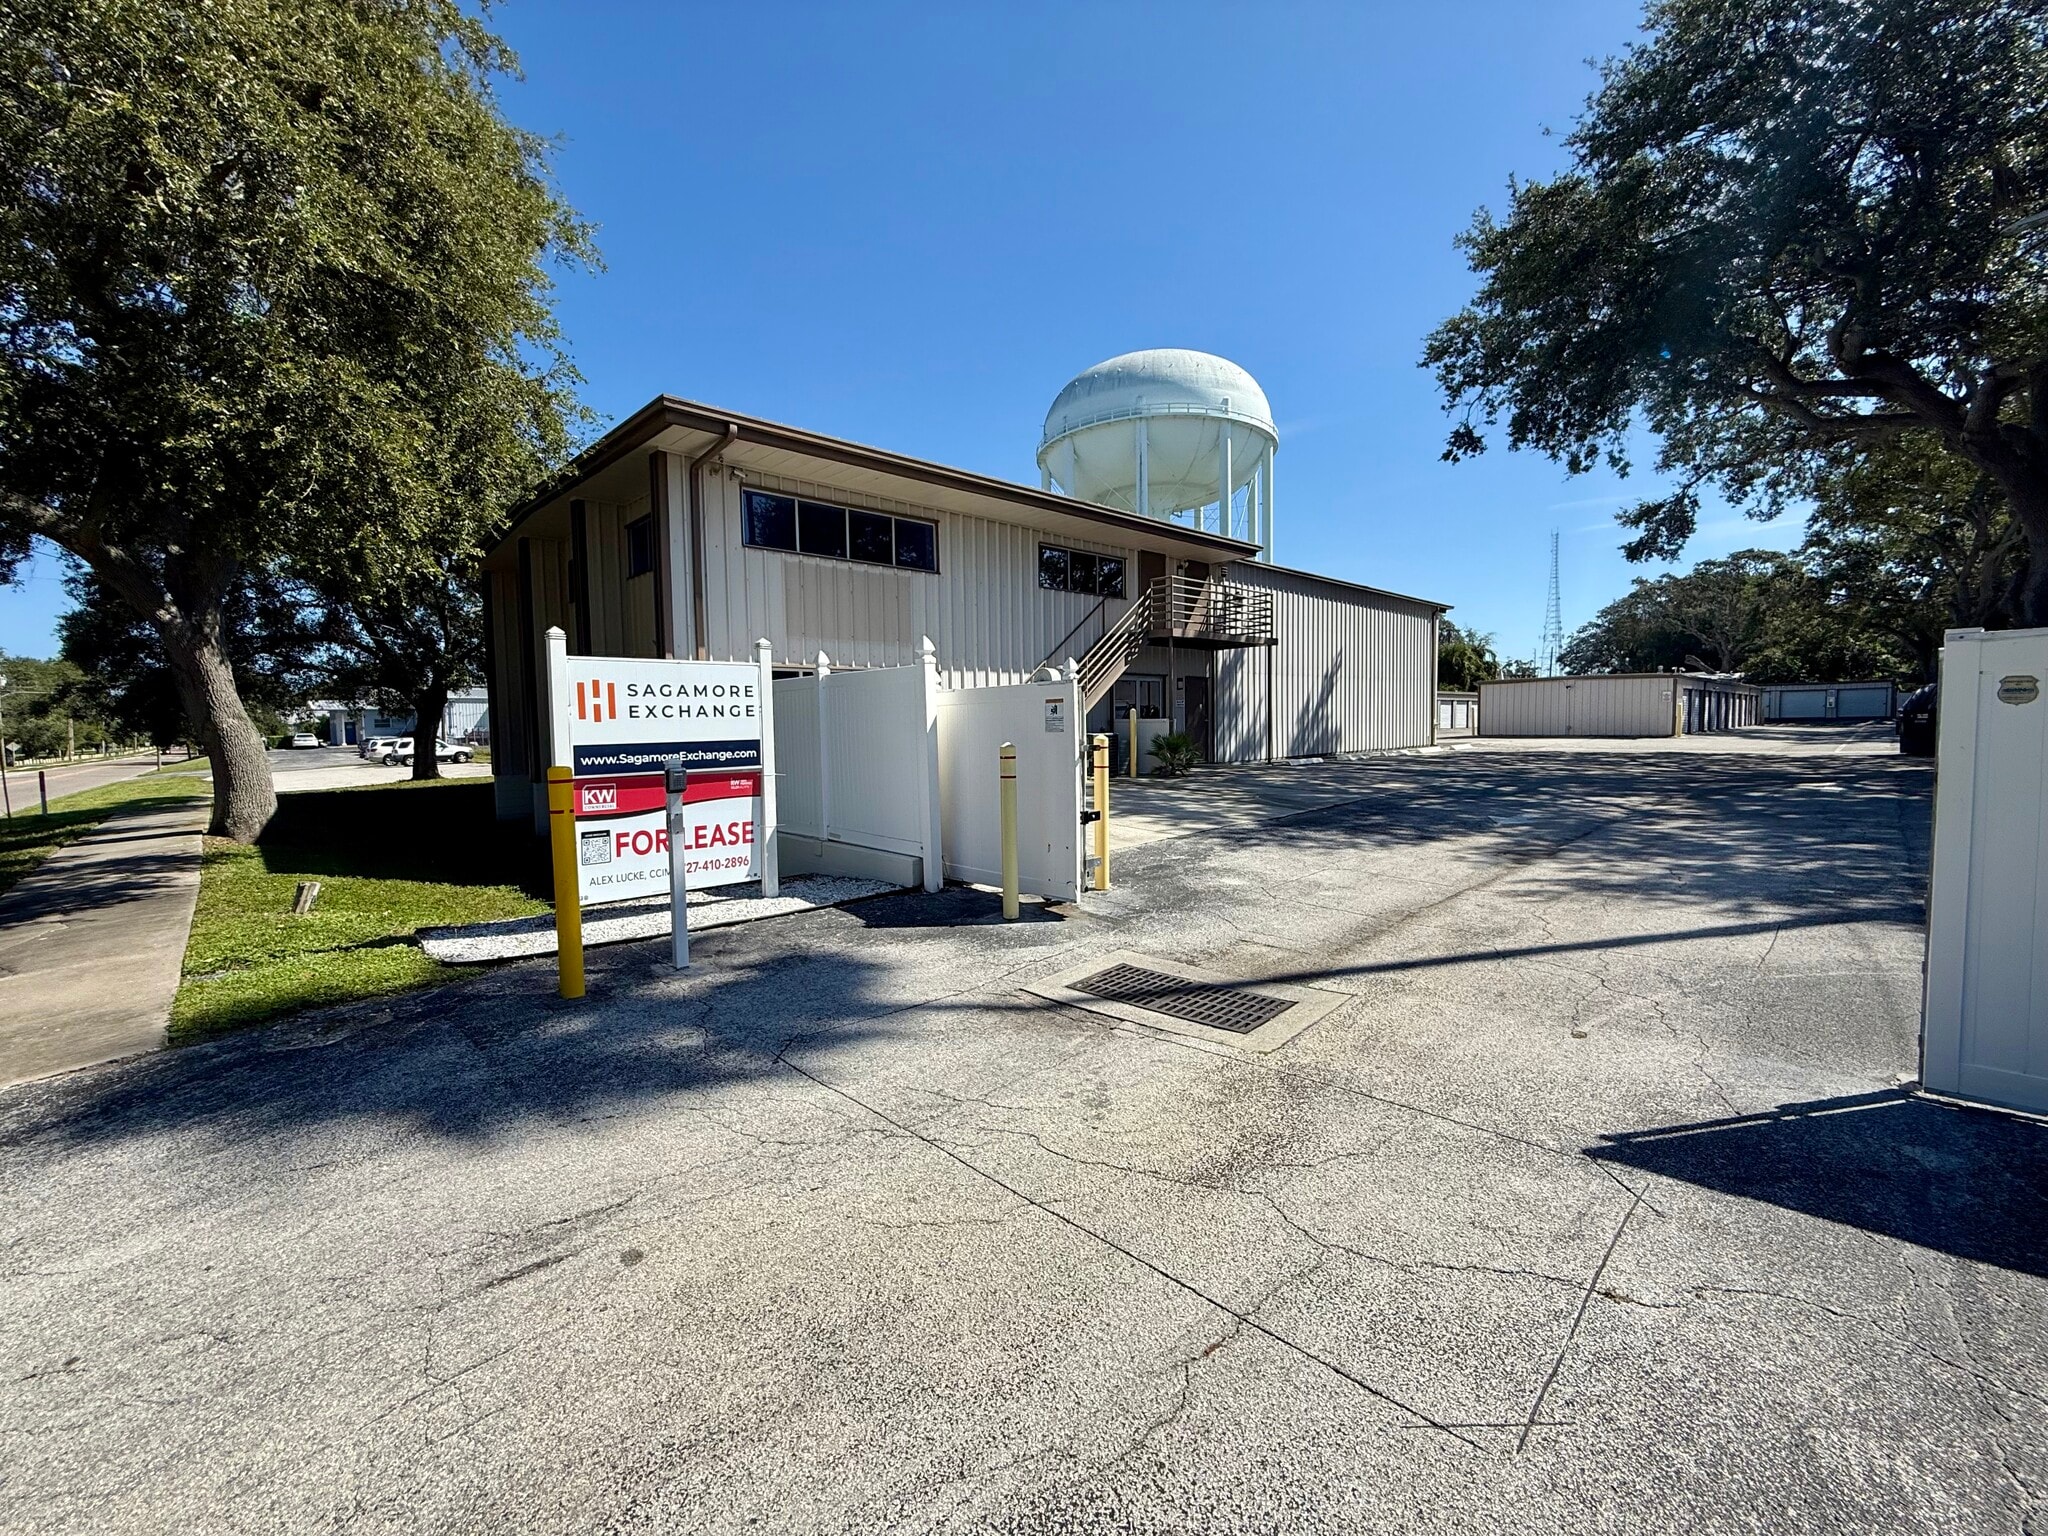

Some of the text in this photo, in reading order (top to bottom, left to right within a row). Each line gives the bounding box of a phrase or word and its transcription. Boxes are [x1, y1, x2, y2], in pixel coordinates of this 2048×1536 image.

[627, 683, 754, 698] SAGAMORE
[629, 705, 756, 719] EXCHANGE
[580, 749, 757, 766] www.SagamoreExchange.com
[584, 789, 614, 804] KW
[616, 829, 670, 858] FOR
[589, 875, 614, 886] ALEX
[616, 871, 647, 883] LUCKE,
[684, 855, 750, 873] 27-410-2896
